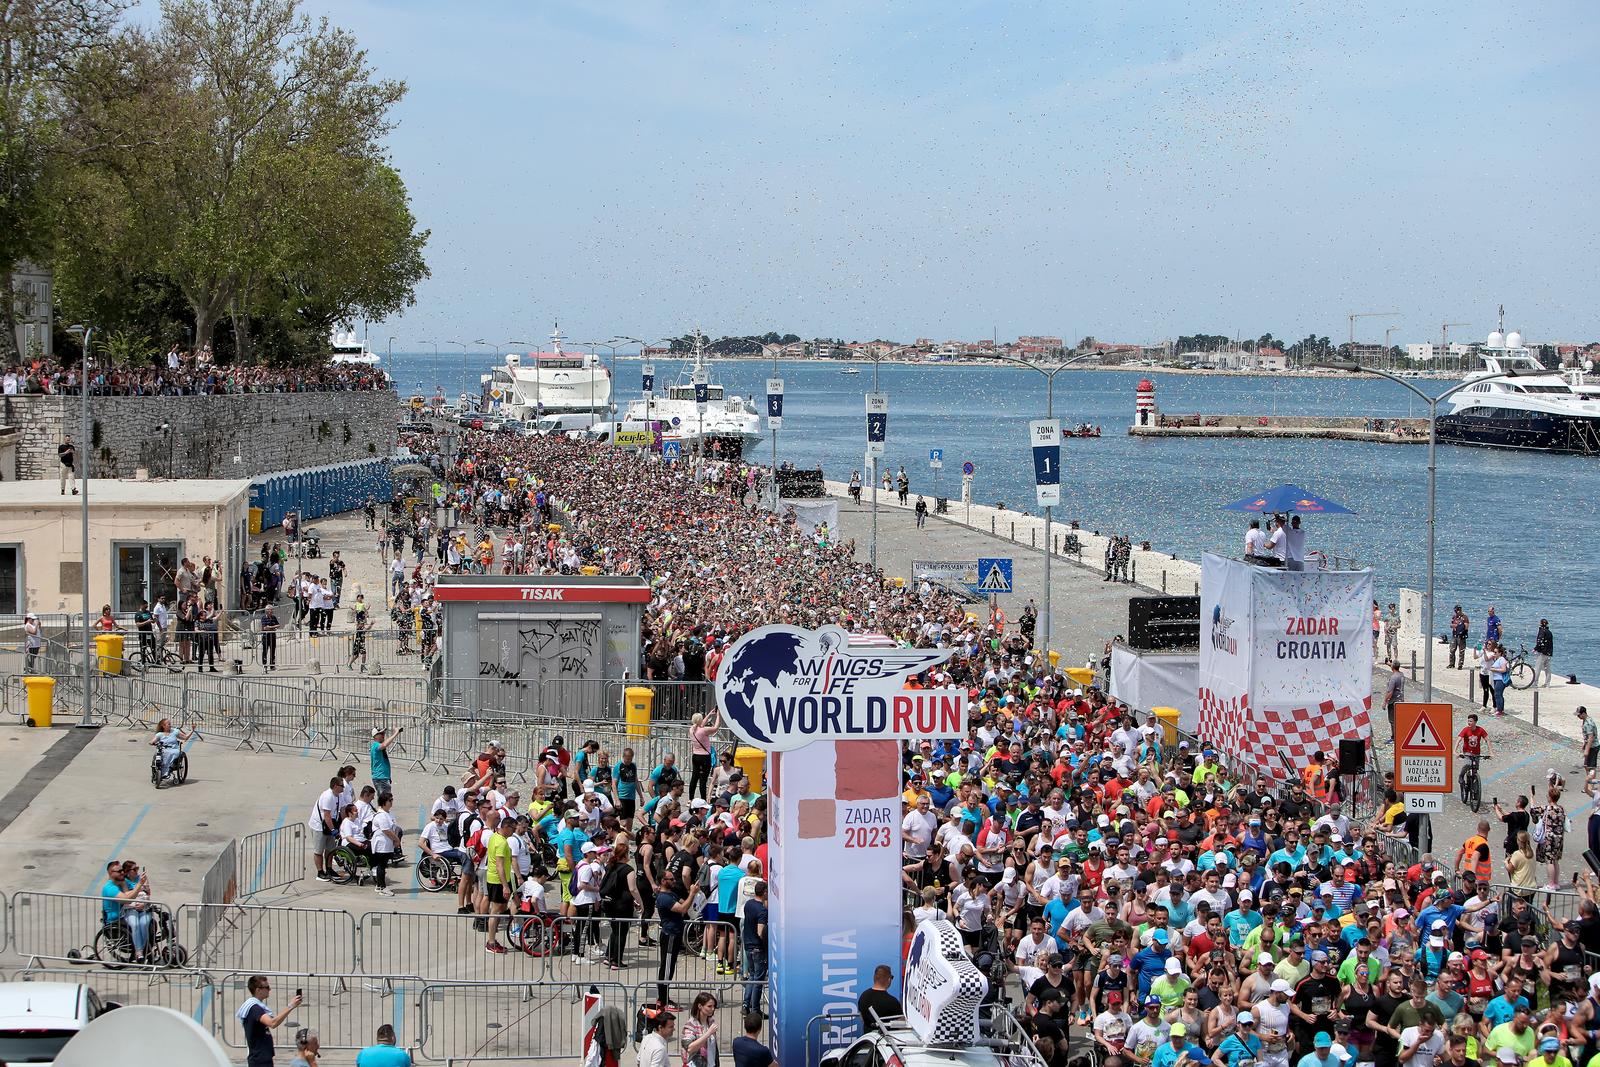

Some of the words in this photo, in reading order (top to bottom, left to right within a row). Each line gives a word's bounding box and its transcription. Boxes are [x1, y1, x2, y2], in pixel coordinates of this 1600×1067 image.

[700, 388, 704, 398] 3
[772, 400, 778, 411] 3
[874, 422, 880, 434] 2
[1036, 426, 1054, 434] ZONA
[933, 451, 940, 460] P
[1044, 457, 1050, 474] 1
[520, 588, 564, 600] TISAK
[1286, 616, 1339, 636] ZADAR
[1276, 640, 1346, 660] CROATIA
[799, 654, 884, 677] WINGS
[793, 677, 811, 686] FOR
[809, 677, 859, 695] LIFE
[764, 696, 886, 734] WORLD
[892, 696, 960, 733] RUN
[1406, 775, 1441, 783] GRAIŠTA
[1412, 798, 1425, 808] 50
[845, 808, 892, 824] ZADAR
[844, 827, 892, 848] 2023
[822, 928, 858, 1046] ROATIA
